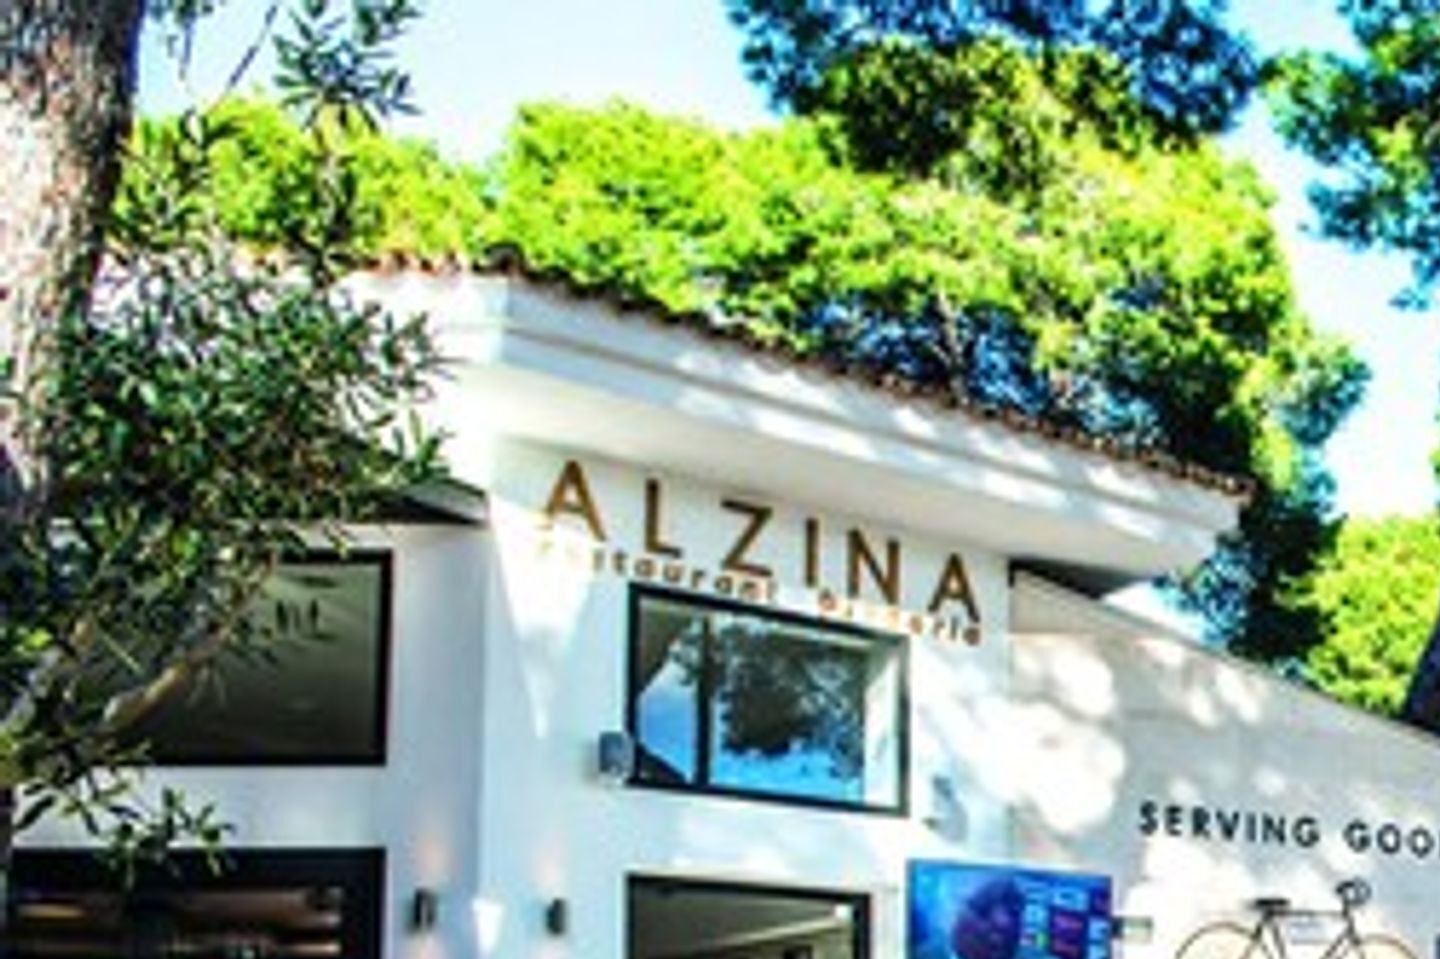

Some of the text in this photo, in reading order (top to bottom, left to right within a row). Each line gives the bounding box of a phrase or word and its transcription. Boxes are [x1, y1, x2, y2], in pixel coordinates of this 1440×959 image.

[537, 538, 780, 602] rstaurant
[544, 459, 982, 625] ALZINA
[1138, 801, 1321, 850] SERVING
